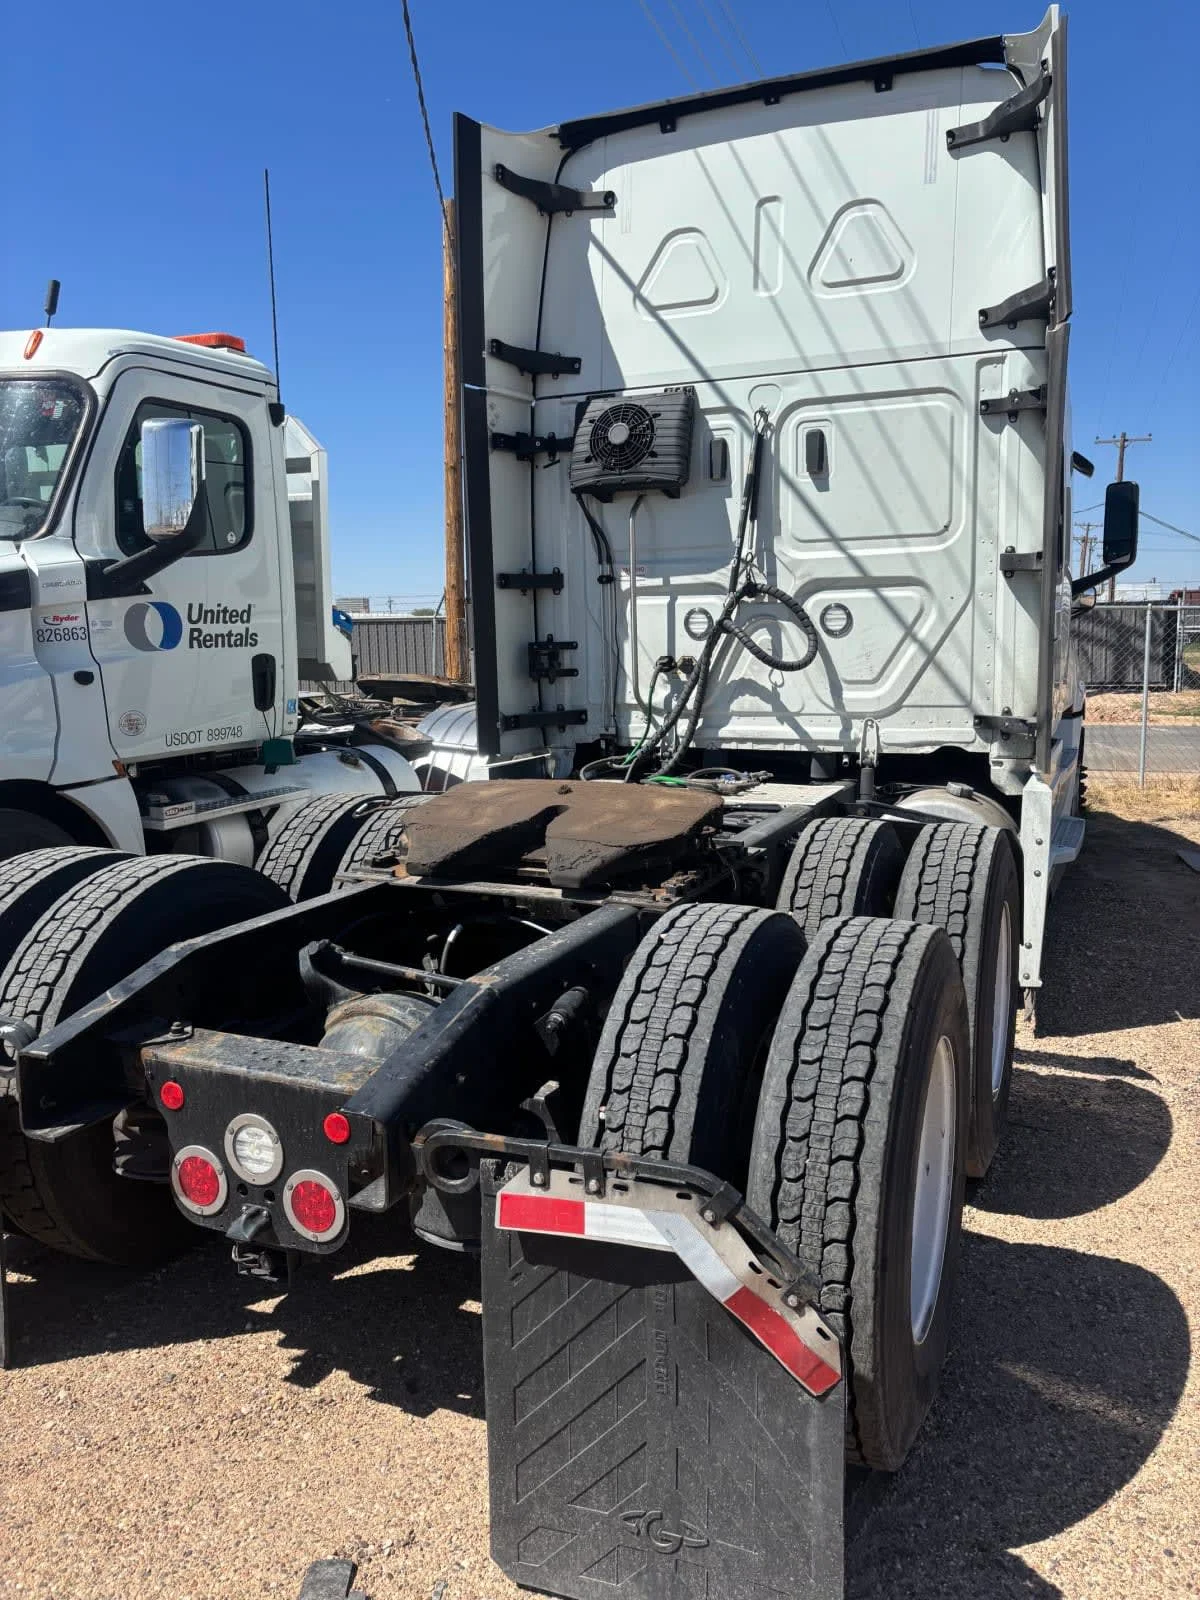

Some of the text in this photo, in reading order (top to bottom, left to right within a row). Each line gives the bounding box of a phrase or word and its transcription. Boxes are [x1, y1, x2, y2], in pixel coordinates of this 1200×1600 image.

[52, 614, 80, 624] Ryder
[187, 602, 252, 625] United
[36, 626, 87, 643] 826863
[188, 626, 259, 649] Rentals
[165, 724, 243, 748] USDOT 899748
